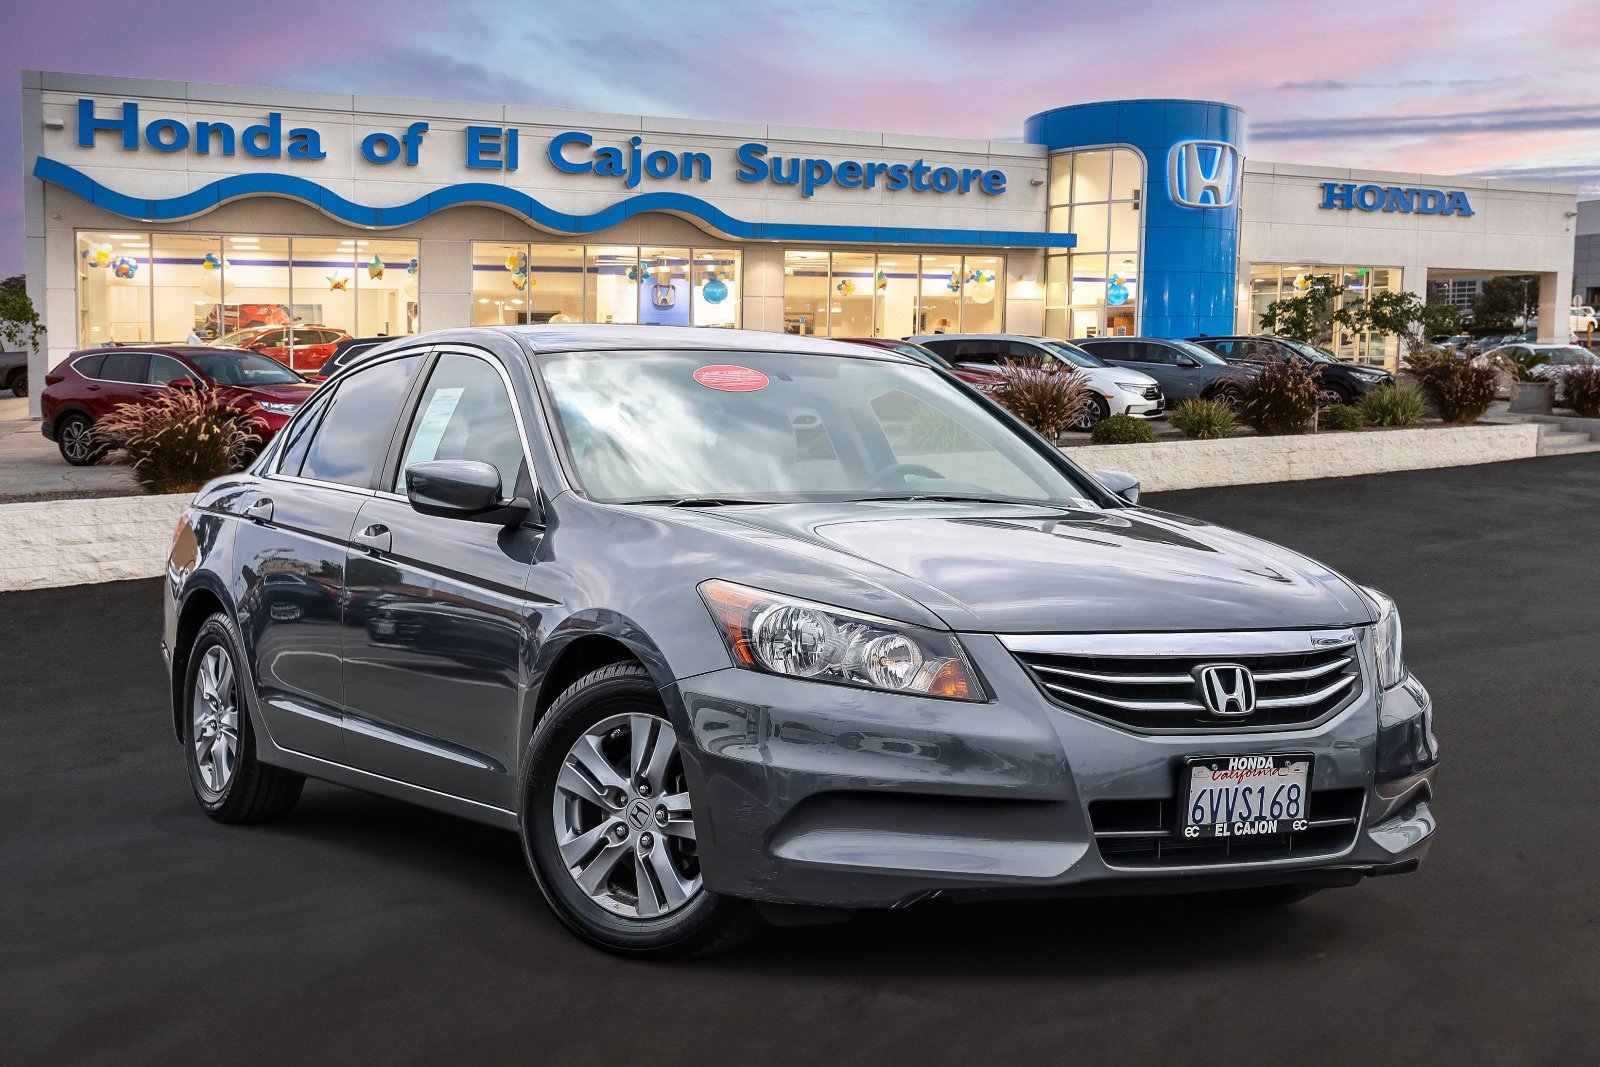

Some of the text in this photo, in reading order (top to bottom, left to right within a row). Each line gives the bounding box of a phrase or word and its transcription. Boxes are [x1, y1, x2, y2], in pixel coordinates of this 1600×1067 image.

[78, 98, 1007, 198] Honda of El Cajon Superstore
[1319, 181, 1475, 217] HONDA
[1211, 767, 1288, 784] California
[1228, 756, 1274, 771] HONDA
[1191, 783, 1301, 825] 6VVS168
[1214, 820, 1278, 837] EL CAJON
